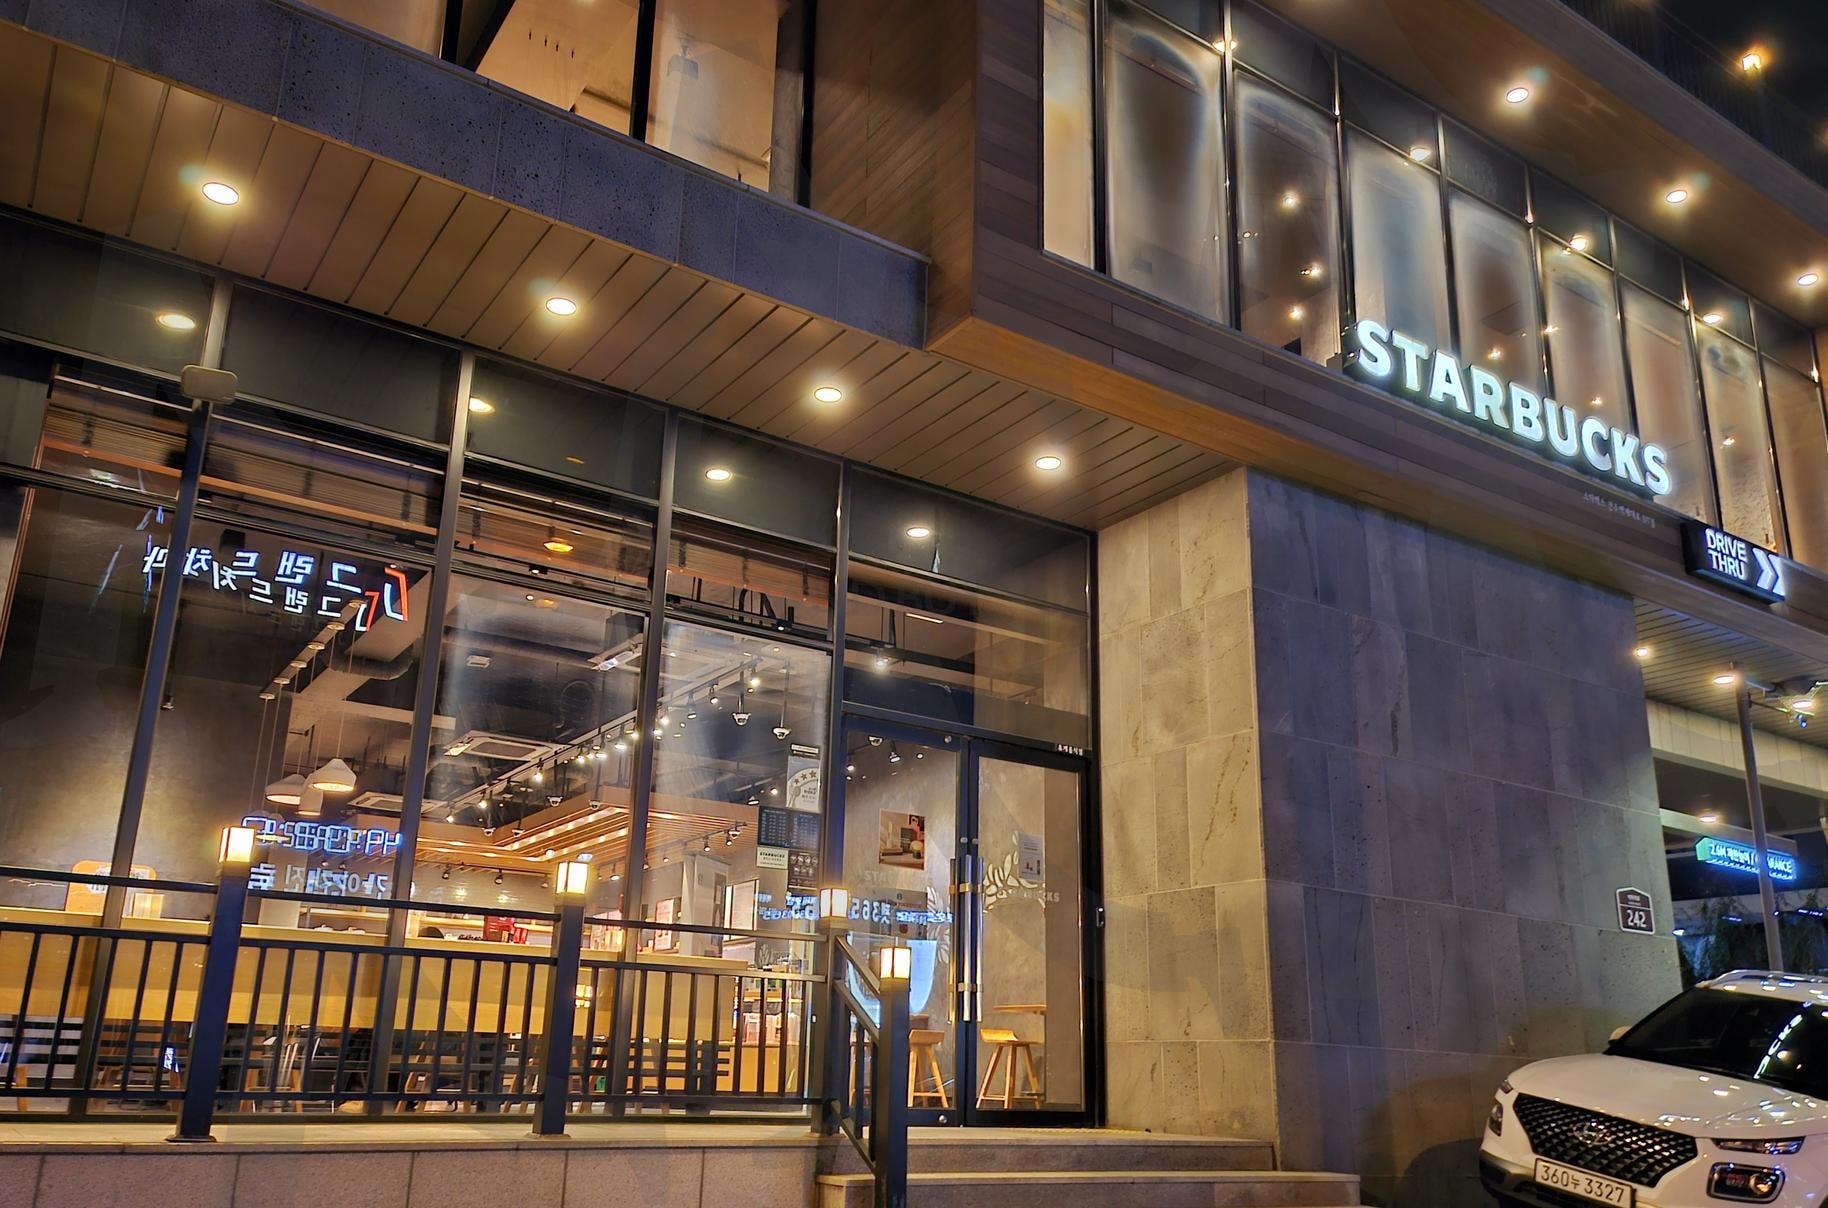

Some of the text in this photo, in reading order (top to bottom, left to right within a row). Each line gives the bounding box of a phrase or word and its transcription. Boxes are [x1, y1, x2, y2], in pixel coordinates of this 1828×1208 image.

[1356, 319, 1672, 496] STARBUCKS
[1705, 527, 1748, 563] DRIVE
[1708, 549, 1746, 580] THRU
[1626, 909, 1647, 928] 242
[1540, 1164, 1625, 1203] 360누 3327
